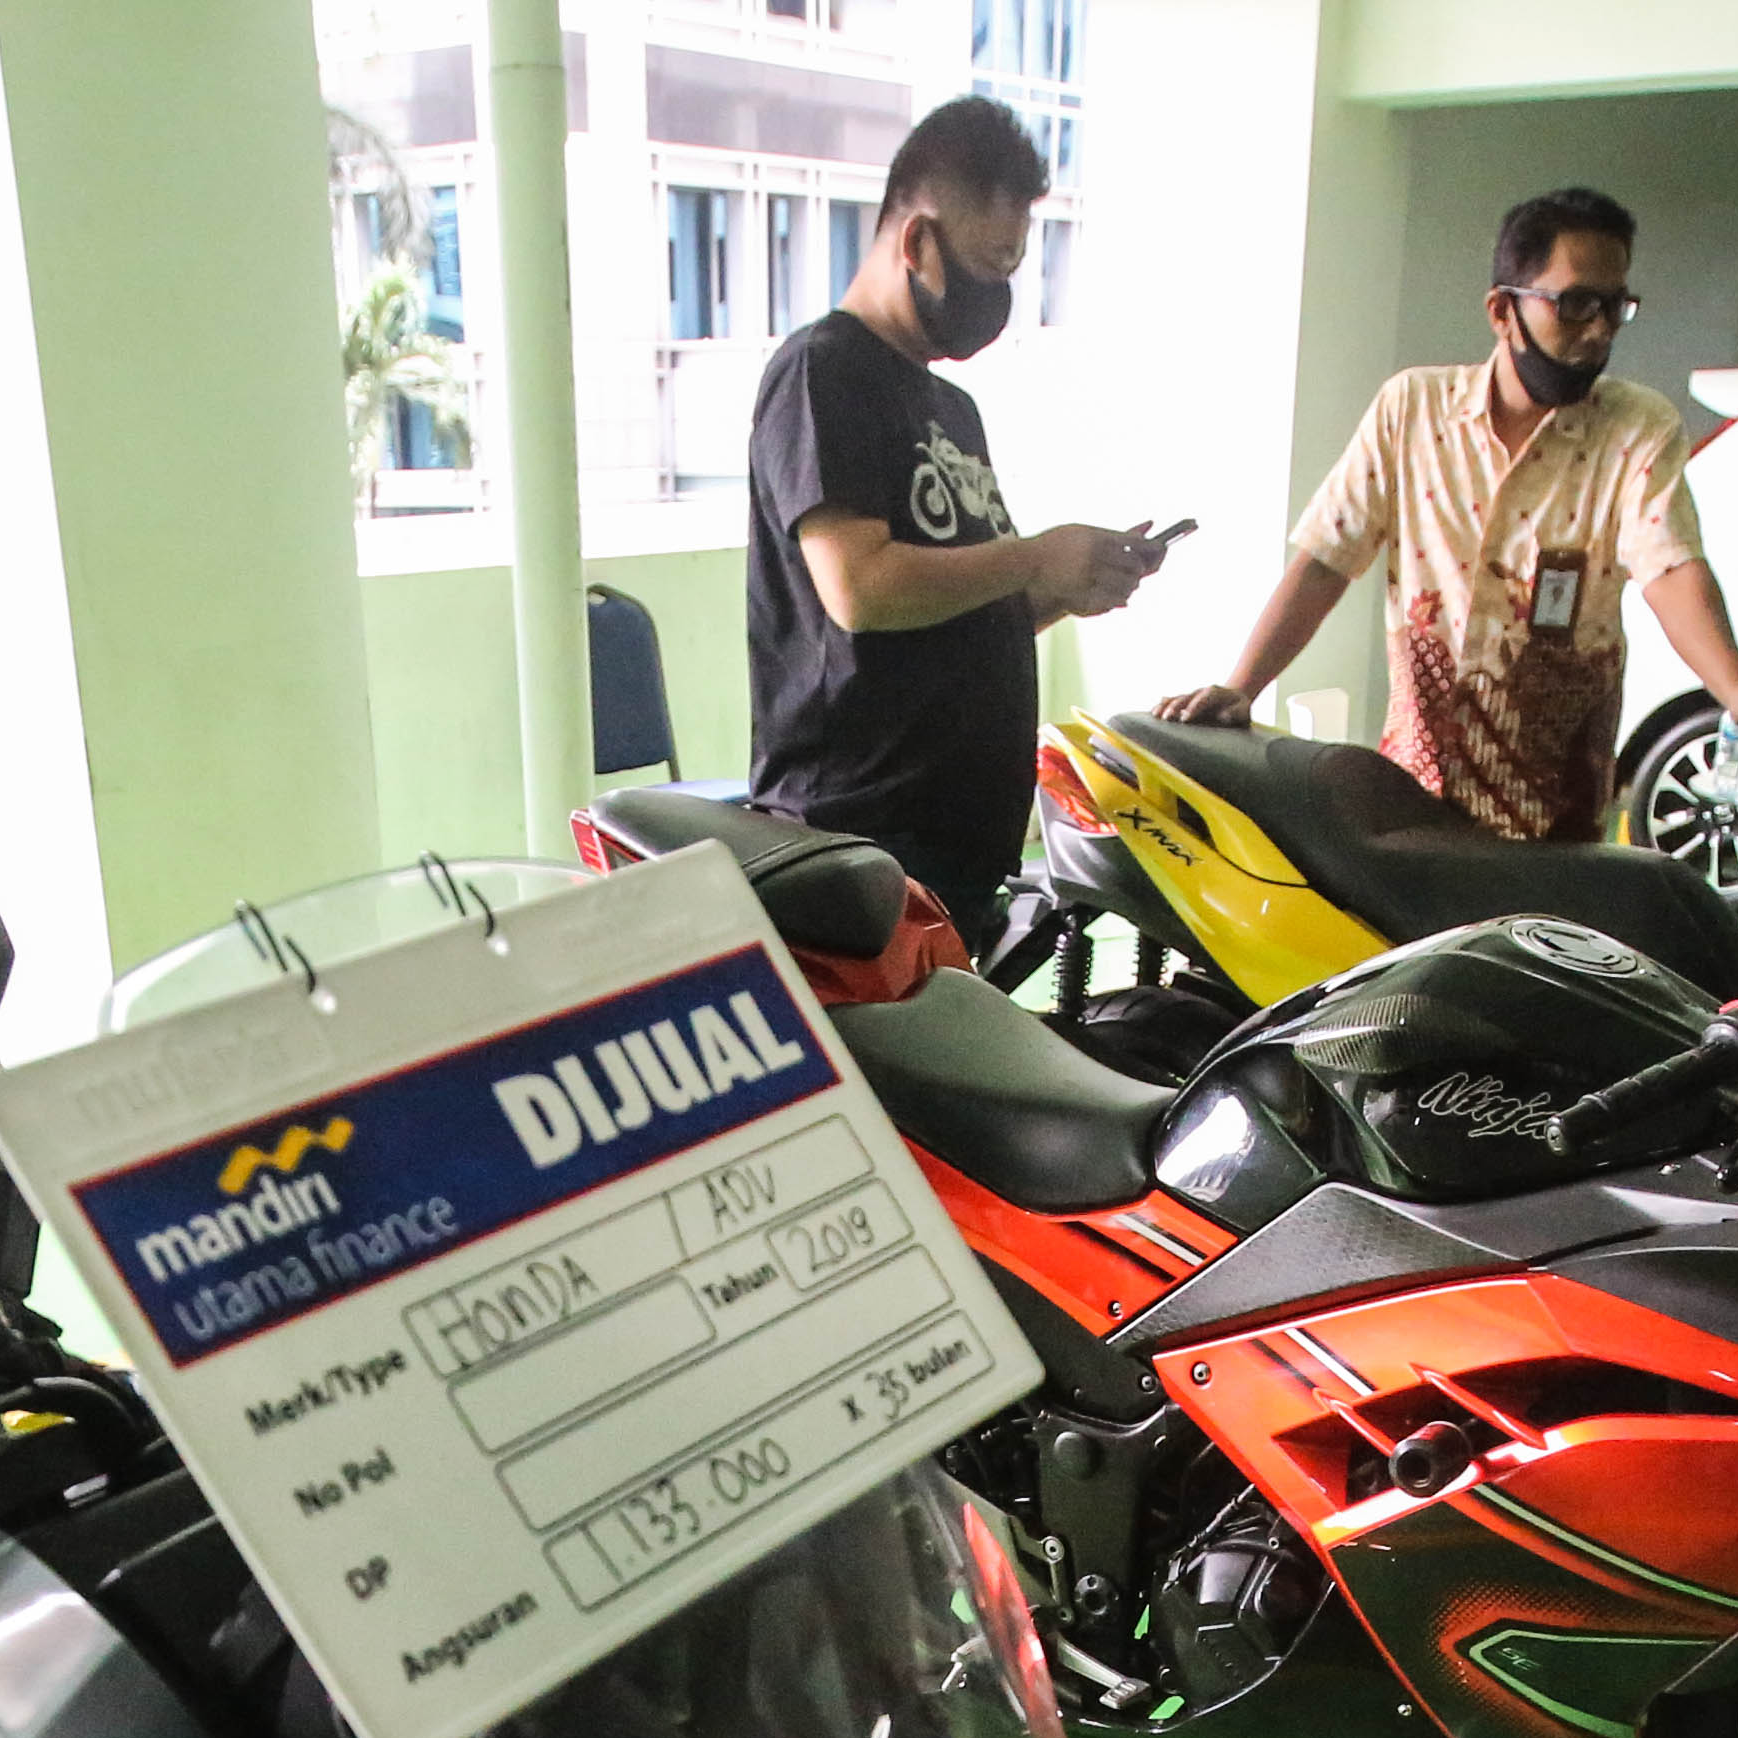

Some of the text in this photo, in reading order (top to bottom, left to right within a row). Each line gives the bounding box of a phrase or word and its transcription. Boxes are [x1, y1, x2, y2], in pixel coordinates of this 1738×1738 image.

[492, 991, 805, 1169] DIJUAL
[1418, 1072, 1556, 1139] Ninja
[135, 1172, 342, 1284] mandiri
[703, 1163, 777, 1233] ADV
[172, 1196, 460, 1341] utama finance
[787, 1205, 875, 1273] 2019
[701, 1257, 780, 1310] Tahun
[244, 1348, 408, 1436] Merk/Type
[865, 1365, 911, 1422] 35
[903, 1338, 972, 1386] bulan
[293, 1446, 397, 1518] No Pol
[345, 1555, 390, 1600] DP
[400, 1590, 540, 1684] Angsuran
